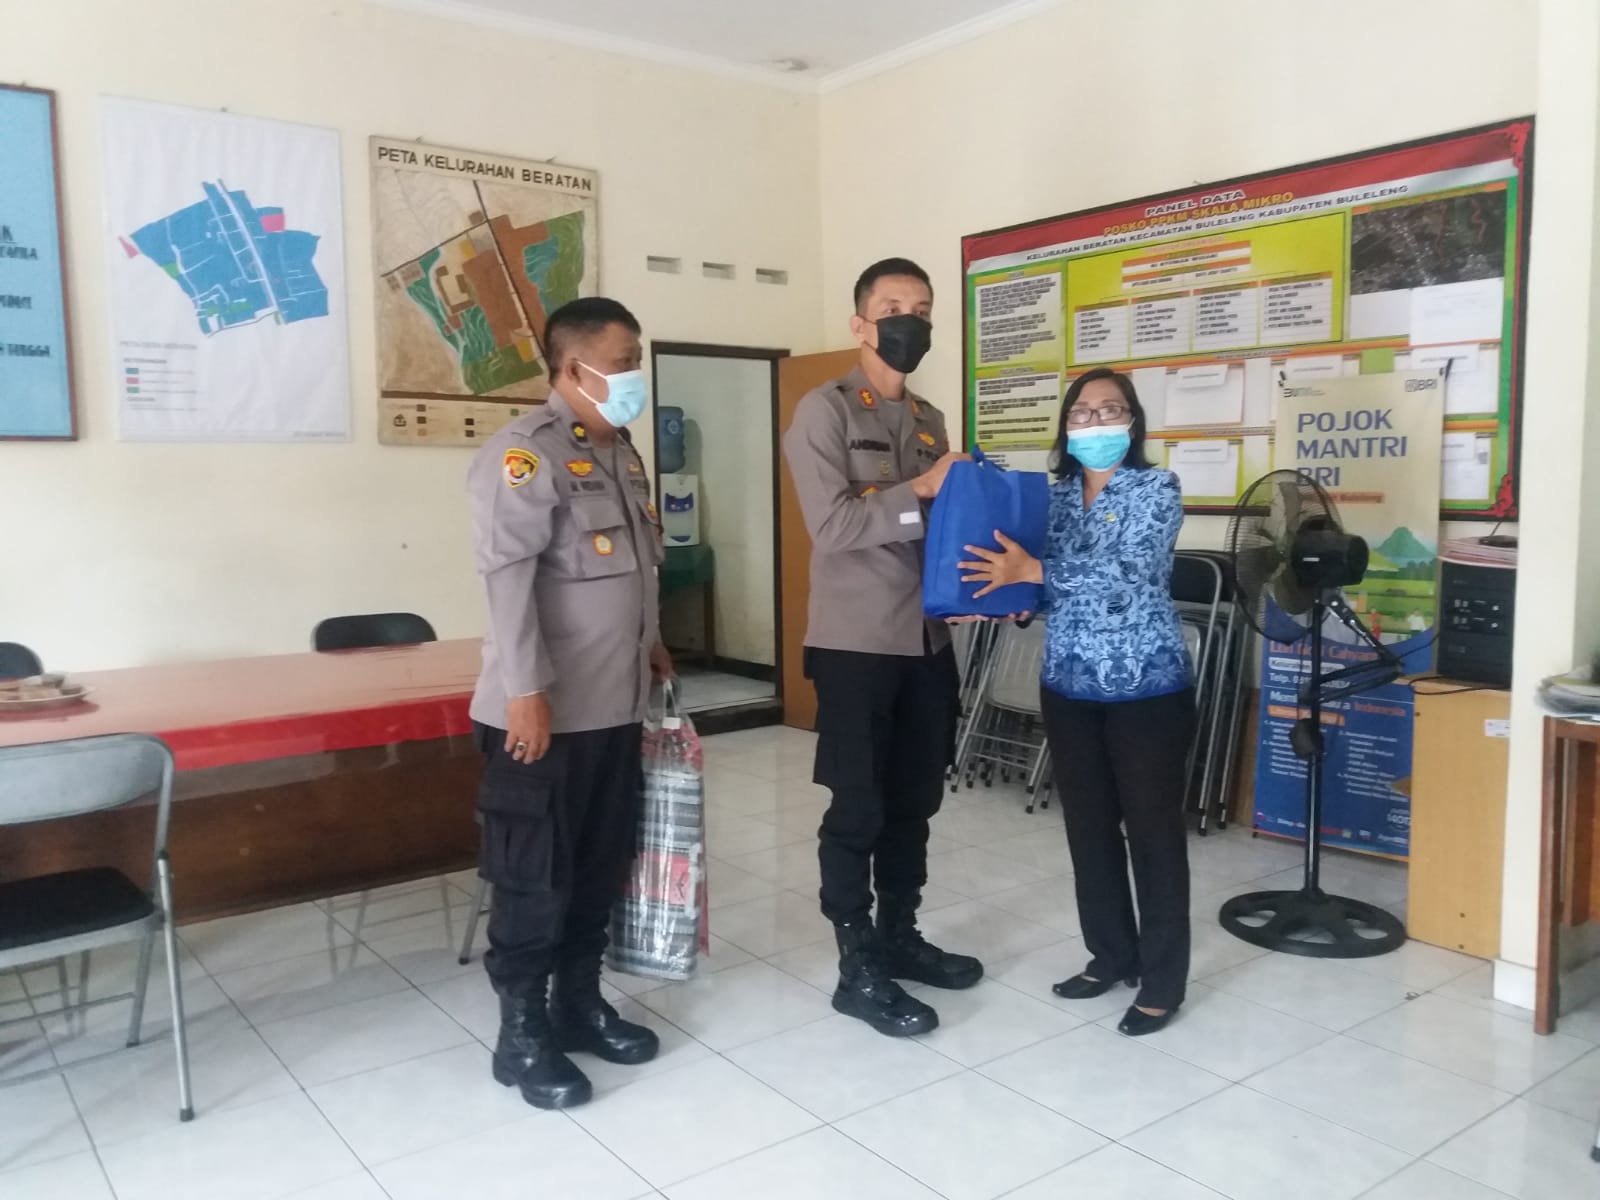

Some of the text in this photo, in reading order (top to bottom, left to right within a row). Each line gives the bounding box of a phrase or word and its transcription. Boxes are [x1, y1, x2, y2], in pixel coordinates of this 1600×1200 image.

[378, 146, 592, 191] PETA KELURAHAN BERATAN
[1103, 191, 1294, 237] POSKO PPKM SKALA MIKRO
[1146, 190, 1244, 217] PANEL DATA
[1026, 246, 1081, 261] KELURAHAN
[1083, 237, 1126, 250] BERATAN
[1130, 225, 1192, 241] KECAMATAN
[1196, 213, 1255, 230] BULELENG
[1259, 199, 1333, 218] KABUPATEN
[1336, 185, 1409, 205] BULELENG
[1416, 379, 1437, 391] BRI
[1298, 409, 1393, 433] POJOK
[1297, 437, 1407, 459] MANTRI
[1297, 467, 1340, 486] BRI
